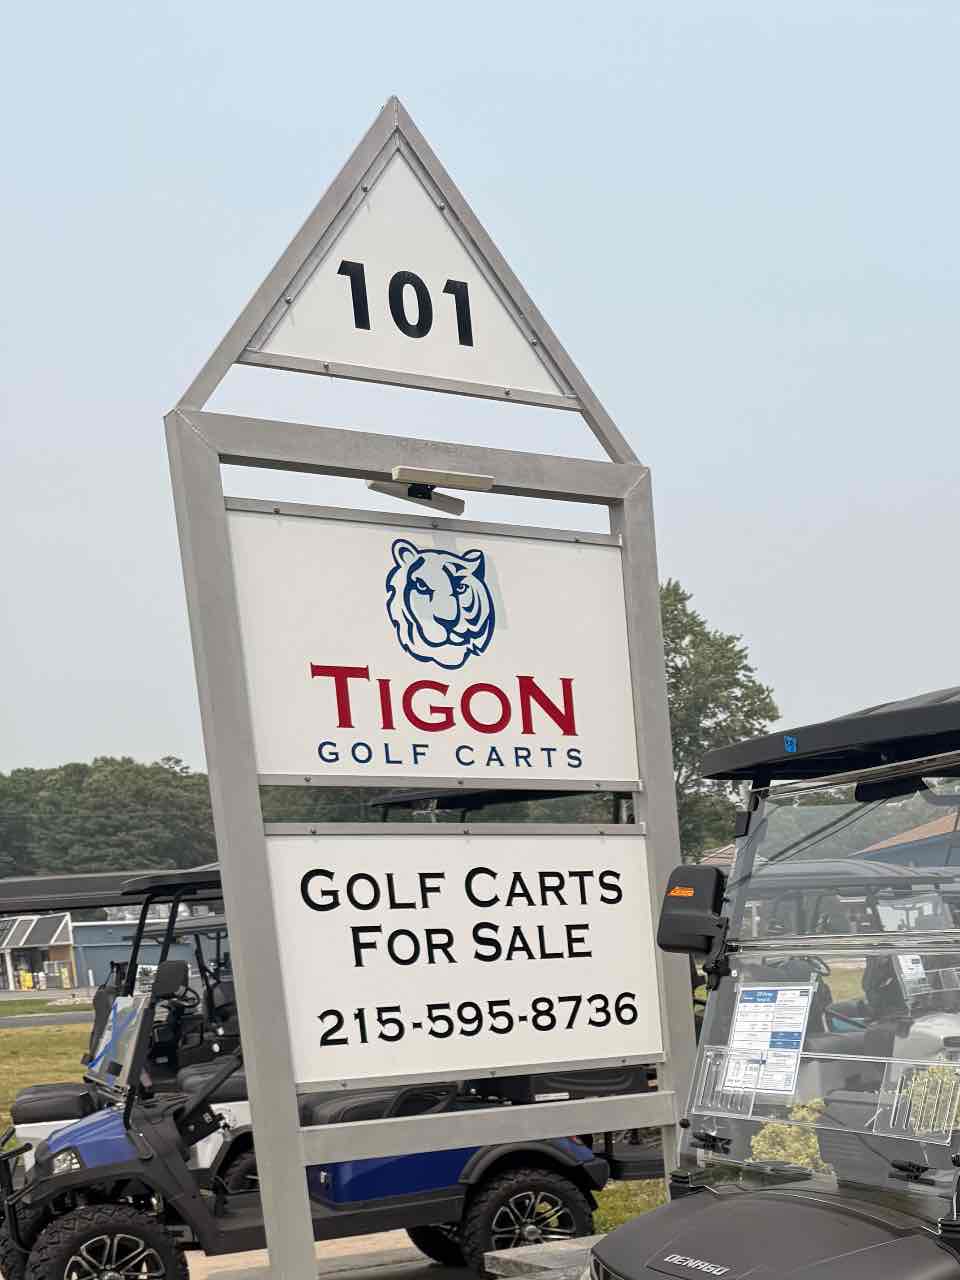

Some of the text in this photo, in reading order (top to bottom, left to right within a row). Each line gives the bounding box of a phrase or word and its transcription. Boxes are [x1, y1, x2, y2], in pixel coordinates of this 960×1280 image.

[337, 260, 475, 348] 101
[310, 662, 579, 737] TIGON
[317, 740, 583, 769] GOLF CARTS
[300, 866, 623, 912] GOLF CARTS
[350, 921, 593, 968] FOR SALE
[317, 991, 639, 1047] 215-595-8736
[664, 1254, 731, 1276] DENAGO
